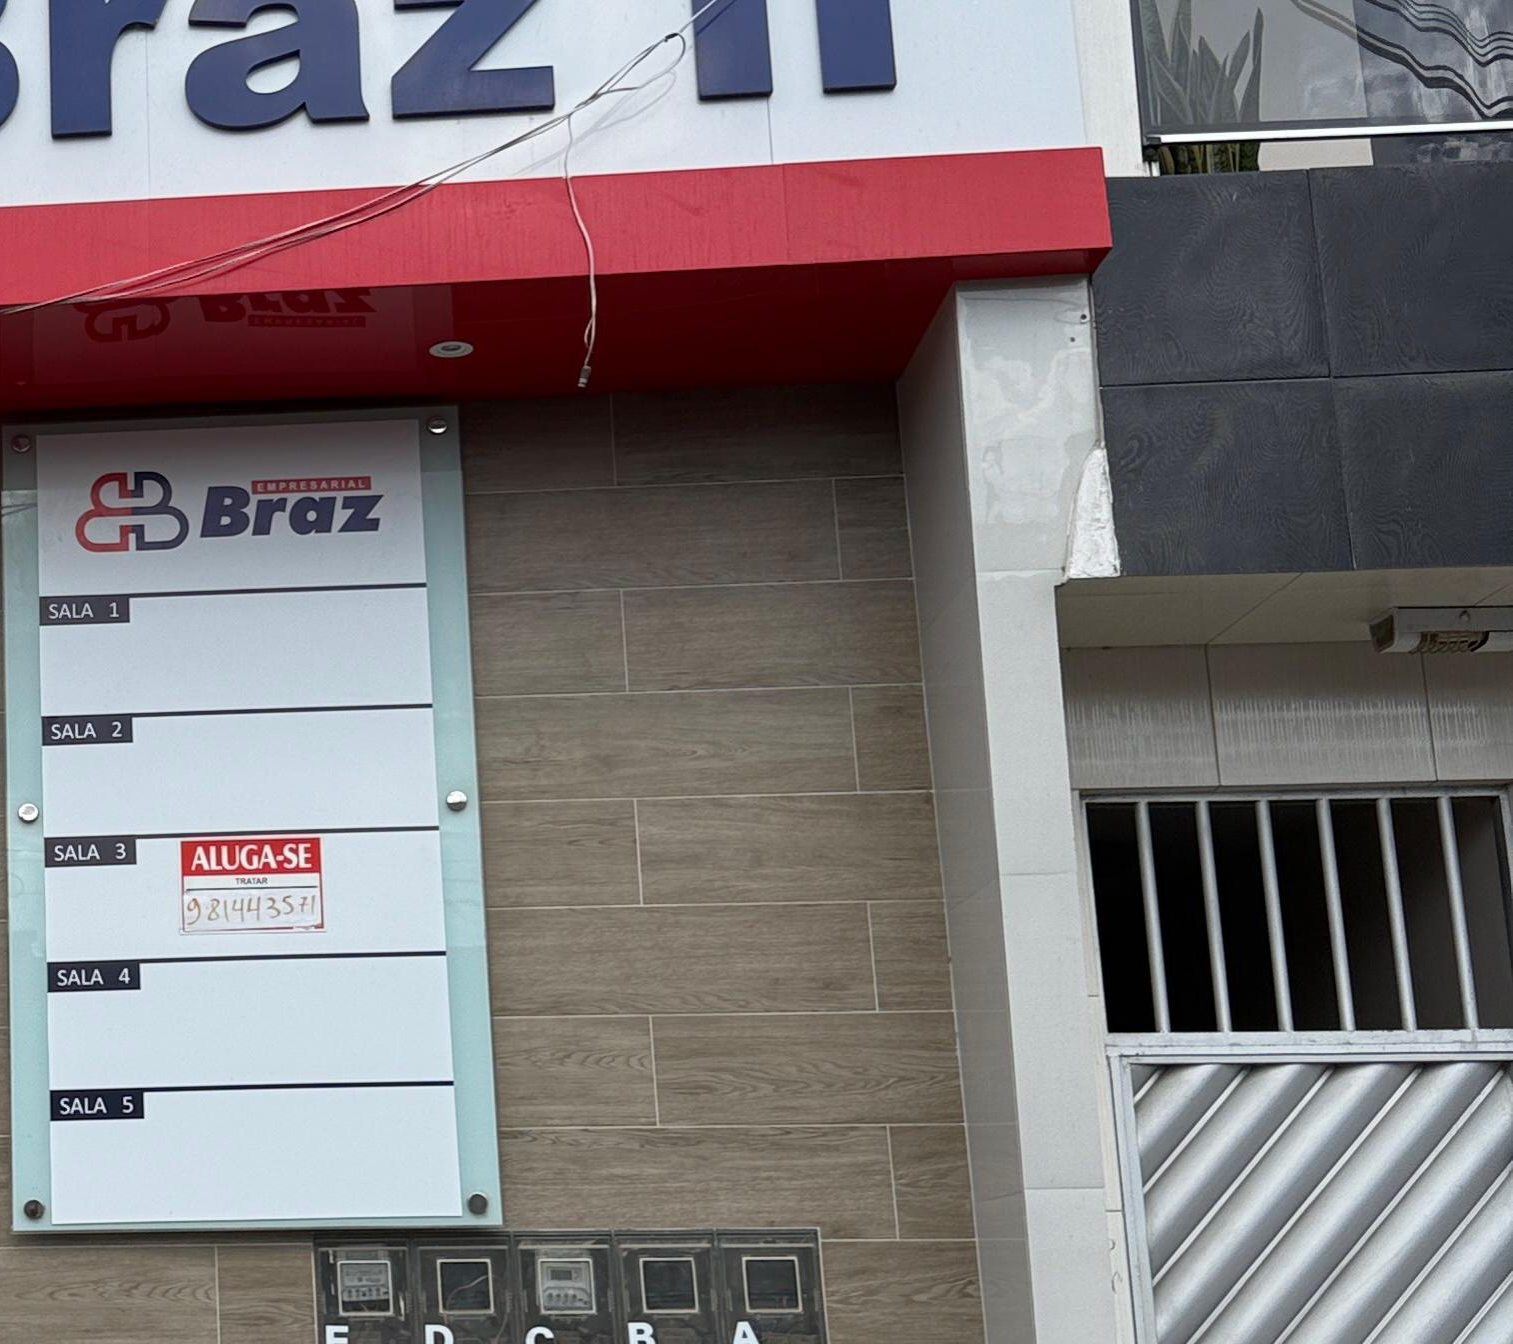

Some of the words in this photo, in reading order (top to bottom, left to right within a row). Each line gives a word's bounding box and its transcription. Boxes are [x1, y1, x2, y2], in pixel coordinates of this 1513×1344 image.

[256, 479, 366, 493] EMPRESARIAL
[200, 486, 384, 538] Braz
[48, 602, 94, 619] SALA
[109, 602, 120, 618] 1
[50, 722, 96, 740] SALA
[111, 721, 123, 738] 2
[53, 843, 100, 862] SALA
[114, 842, 127, 860] 3
[191, 843, 312, 871] ALUGA-SE
[235, 877, 268, 885] TRATAR
[56, 969, 104, 987] SALA
[118, 967, 131, 985] 4
[59, 1097, 107, 1115] SALA
[121, 1096, 134, 1114] 5
